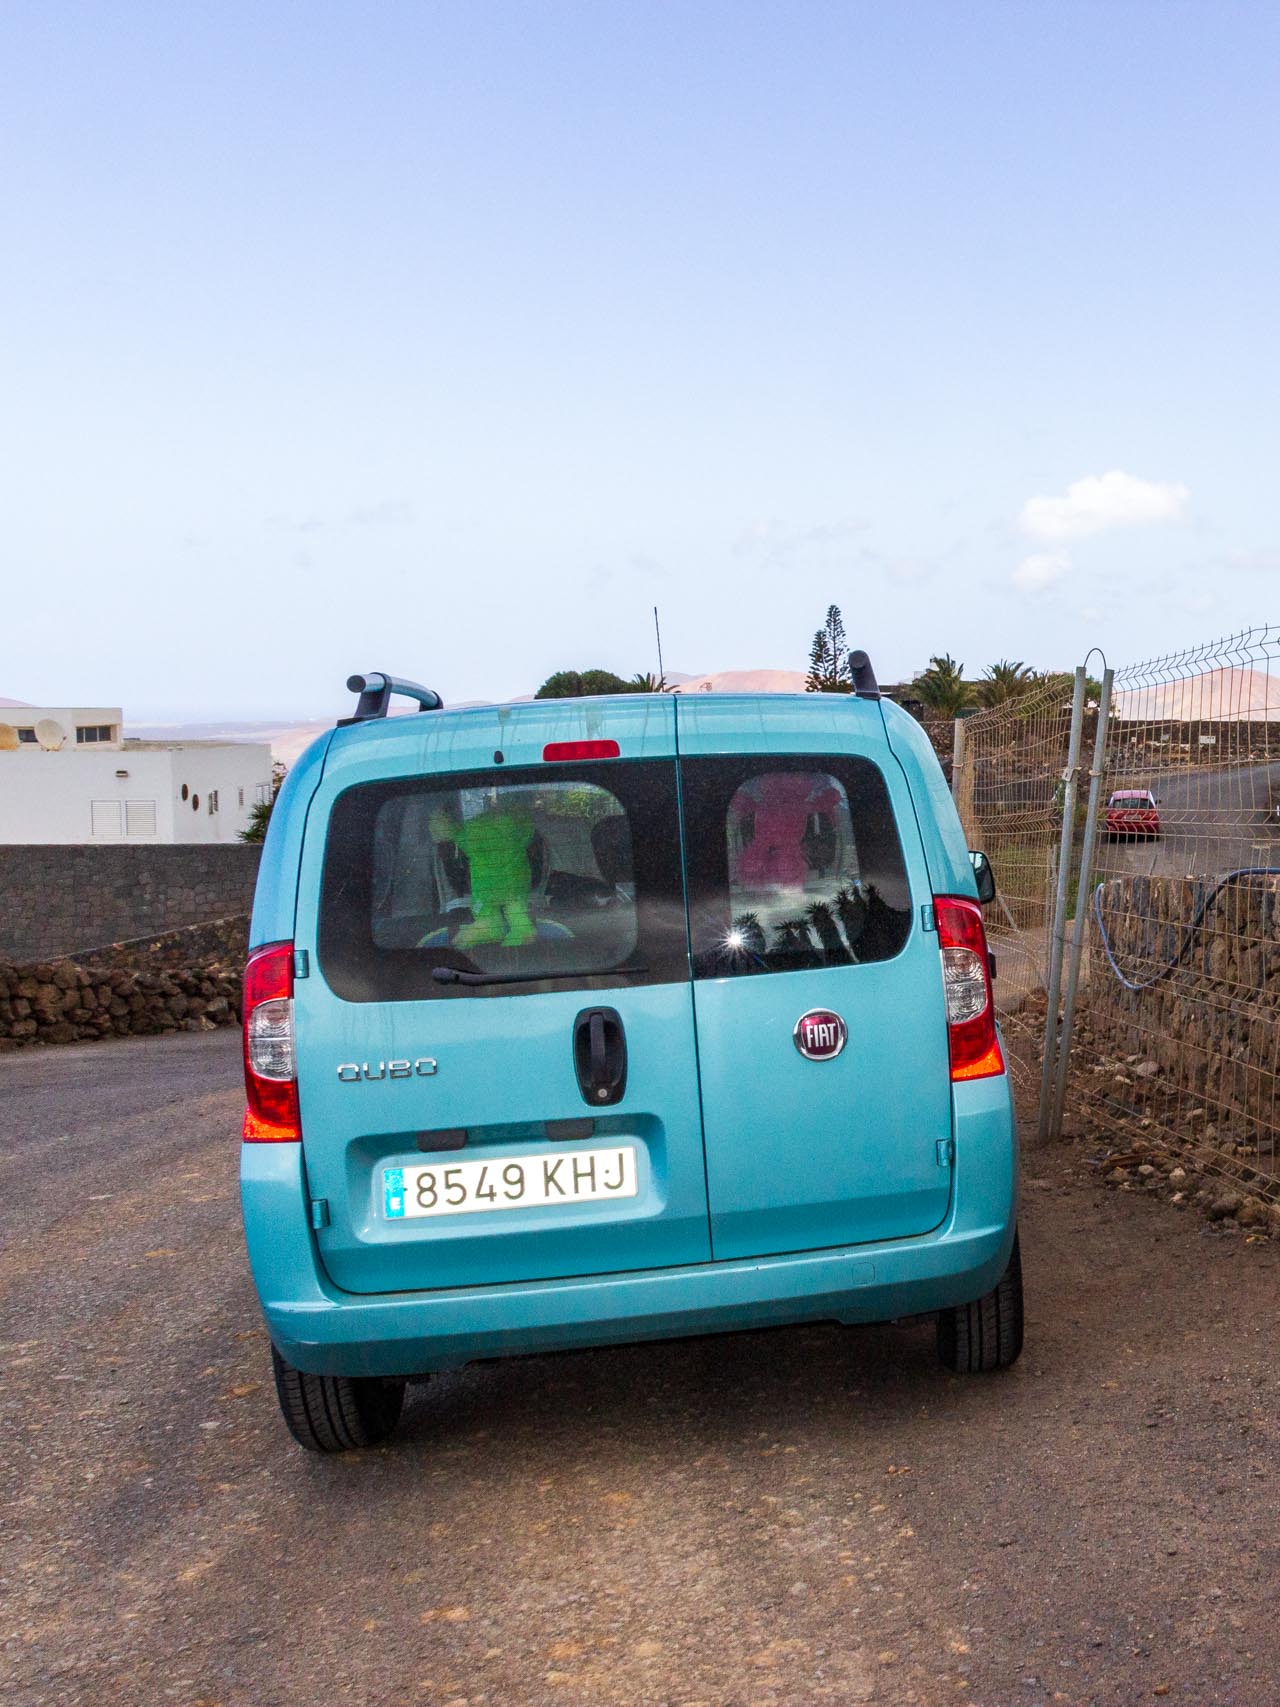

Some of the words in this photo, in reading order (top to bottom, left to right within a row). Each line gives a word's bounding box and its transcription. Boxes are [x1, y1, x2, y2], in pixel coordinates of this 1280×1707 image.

[806, 1023, 836, 1048] FIAT
[337, 1057, 438, 1082] QUBO
[416, 1163, 525, 1209] 8549
[543, 1153, 624, 1197] KHJ
